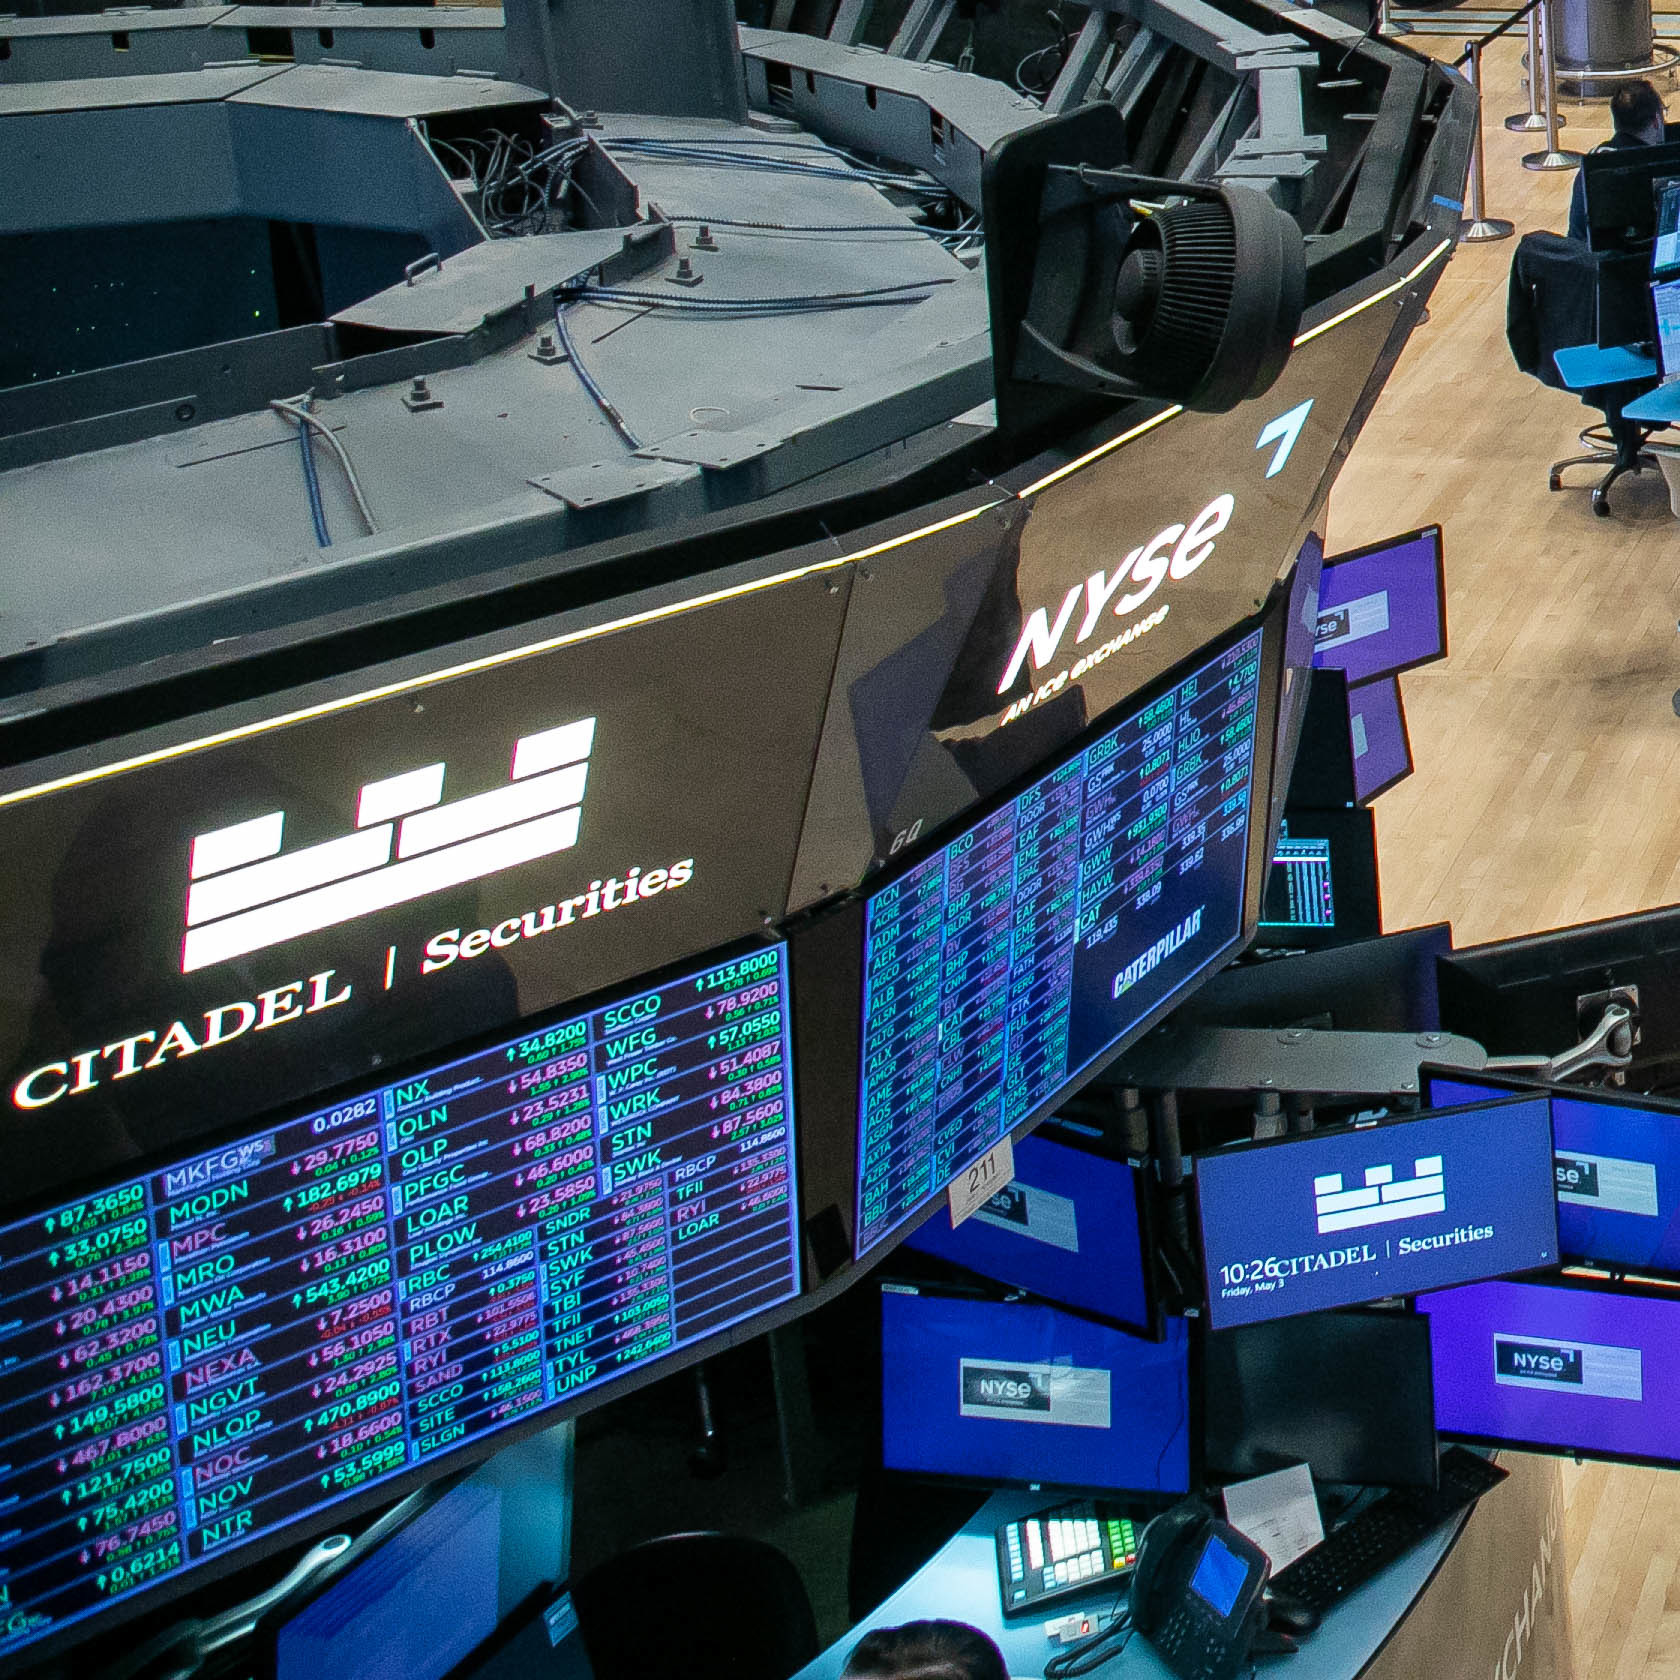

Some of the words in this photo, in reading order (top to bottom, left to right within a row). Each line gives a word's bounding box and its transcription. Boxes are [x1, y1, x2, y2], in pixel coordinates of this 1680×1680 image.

[1002, 697, 1035, 726] AN
[1112, 908, 1202, 1000] CATERPILLAR
[12, 967, 353, 1111] CITADEL
[420, 857, 696, 975] Securities
[603, 996, 662, 1031] SCCO
[605, 1027, 657, 1059] WFG
[312, 1098, 377, 1135] 0.0282
[967, 1153, 1001, 1197] 211
[168, 1179, 249, 1225] MODN
[1274, 1245, 1376, 1278] CITADEL
[1398, 1224, 1494, 1255] Securities
[1220, 1257, 1277, 1285] 10:26
[1221, 1286, 1253, 1298] Friday,
[1255, 1282, 1276, 1293] May
